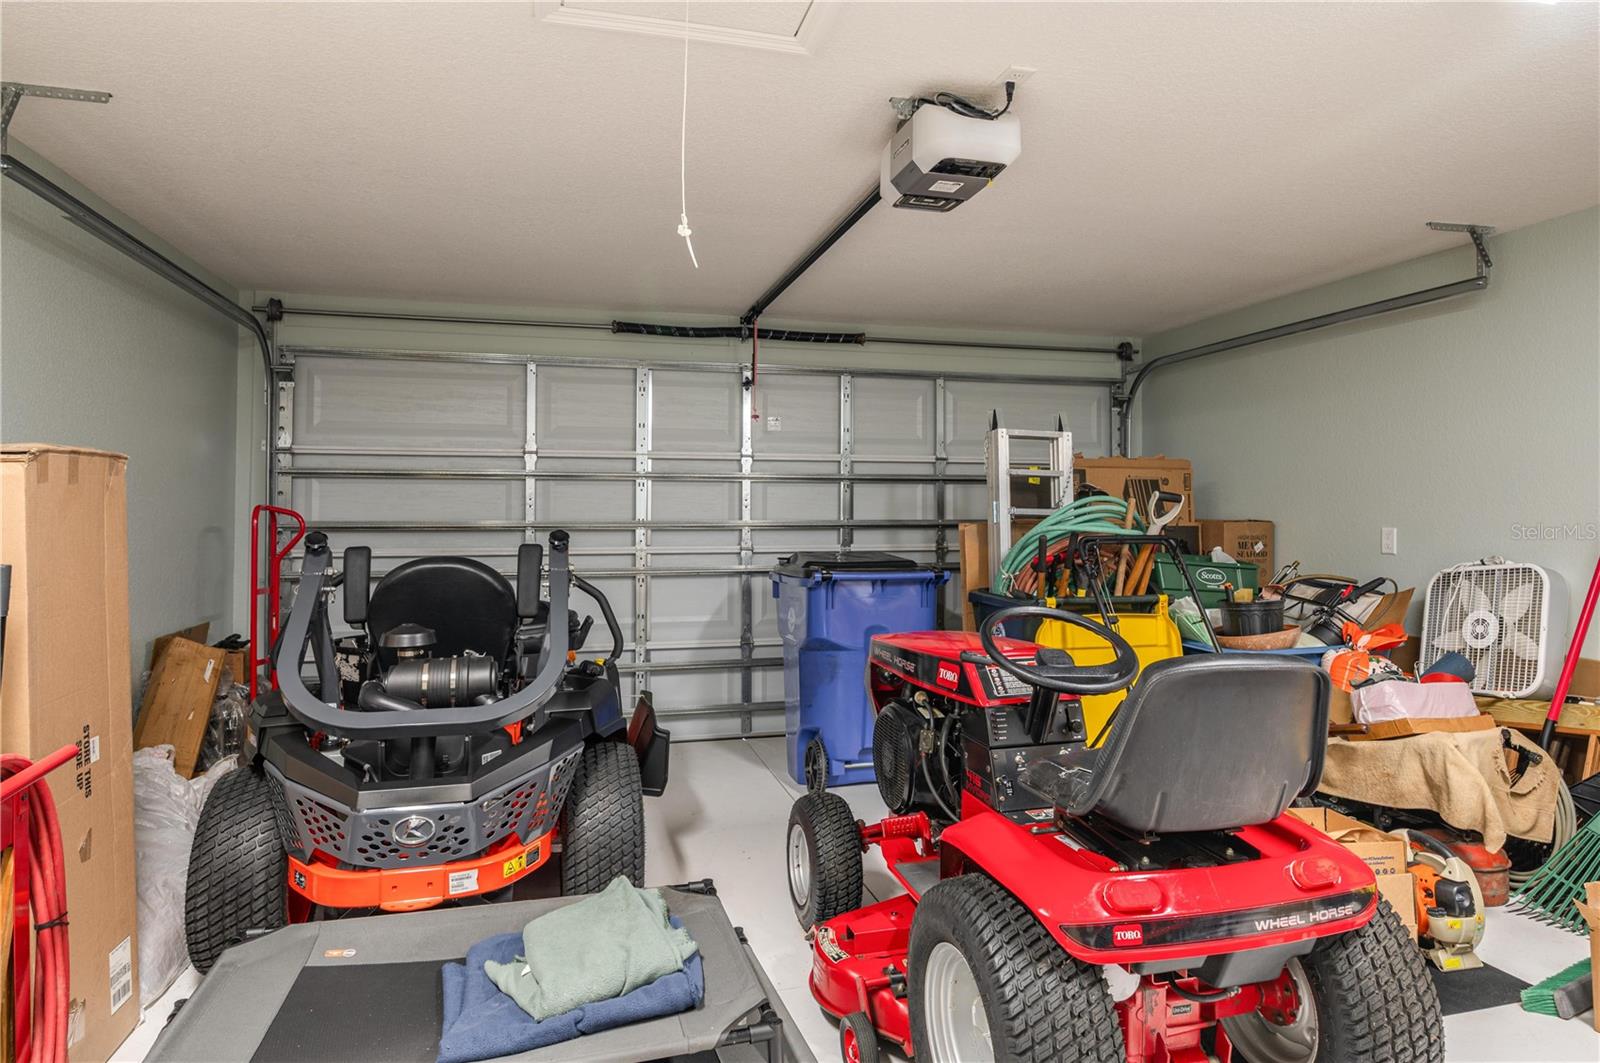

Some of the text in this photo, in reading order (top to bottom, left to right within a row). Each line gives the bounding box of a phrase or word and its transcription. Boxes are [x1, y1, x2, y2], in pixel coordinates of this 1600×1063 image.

[873, 646, 916, 672] WHEEL HORSE
[939, 667, 959, 683] TORO
[83, 724, 93, 799] STORE THIS
[76, 772, 84, 791] UP
[1254, 906, 1353, 931] WHEEL HORSE
[1115, 931, 1142, 941] TORO
